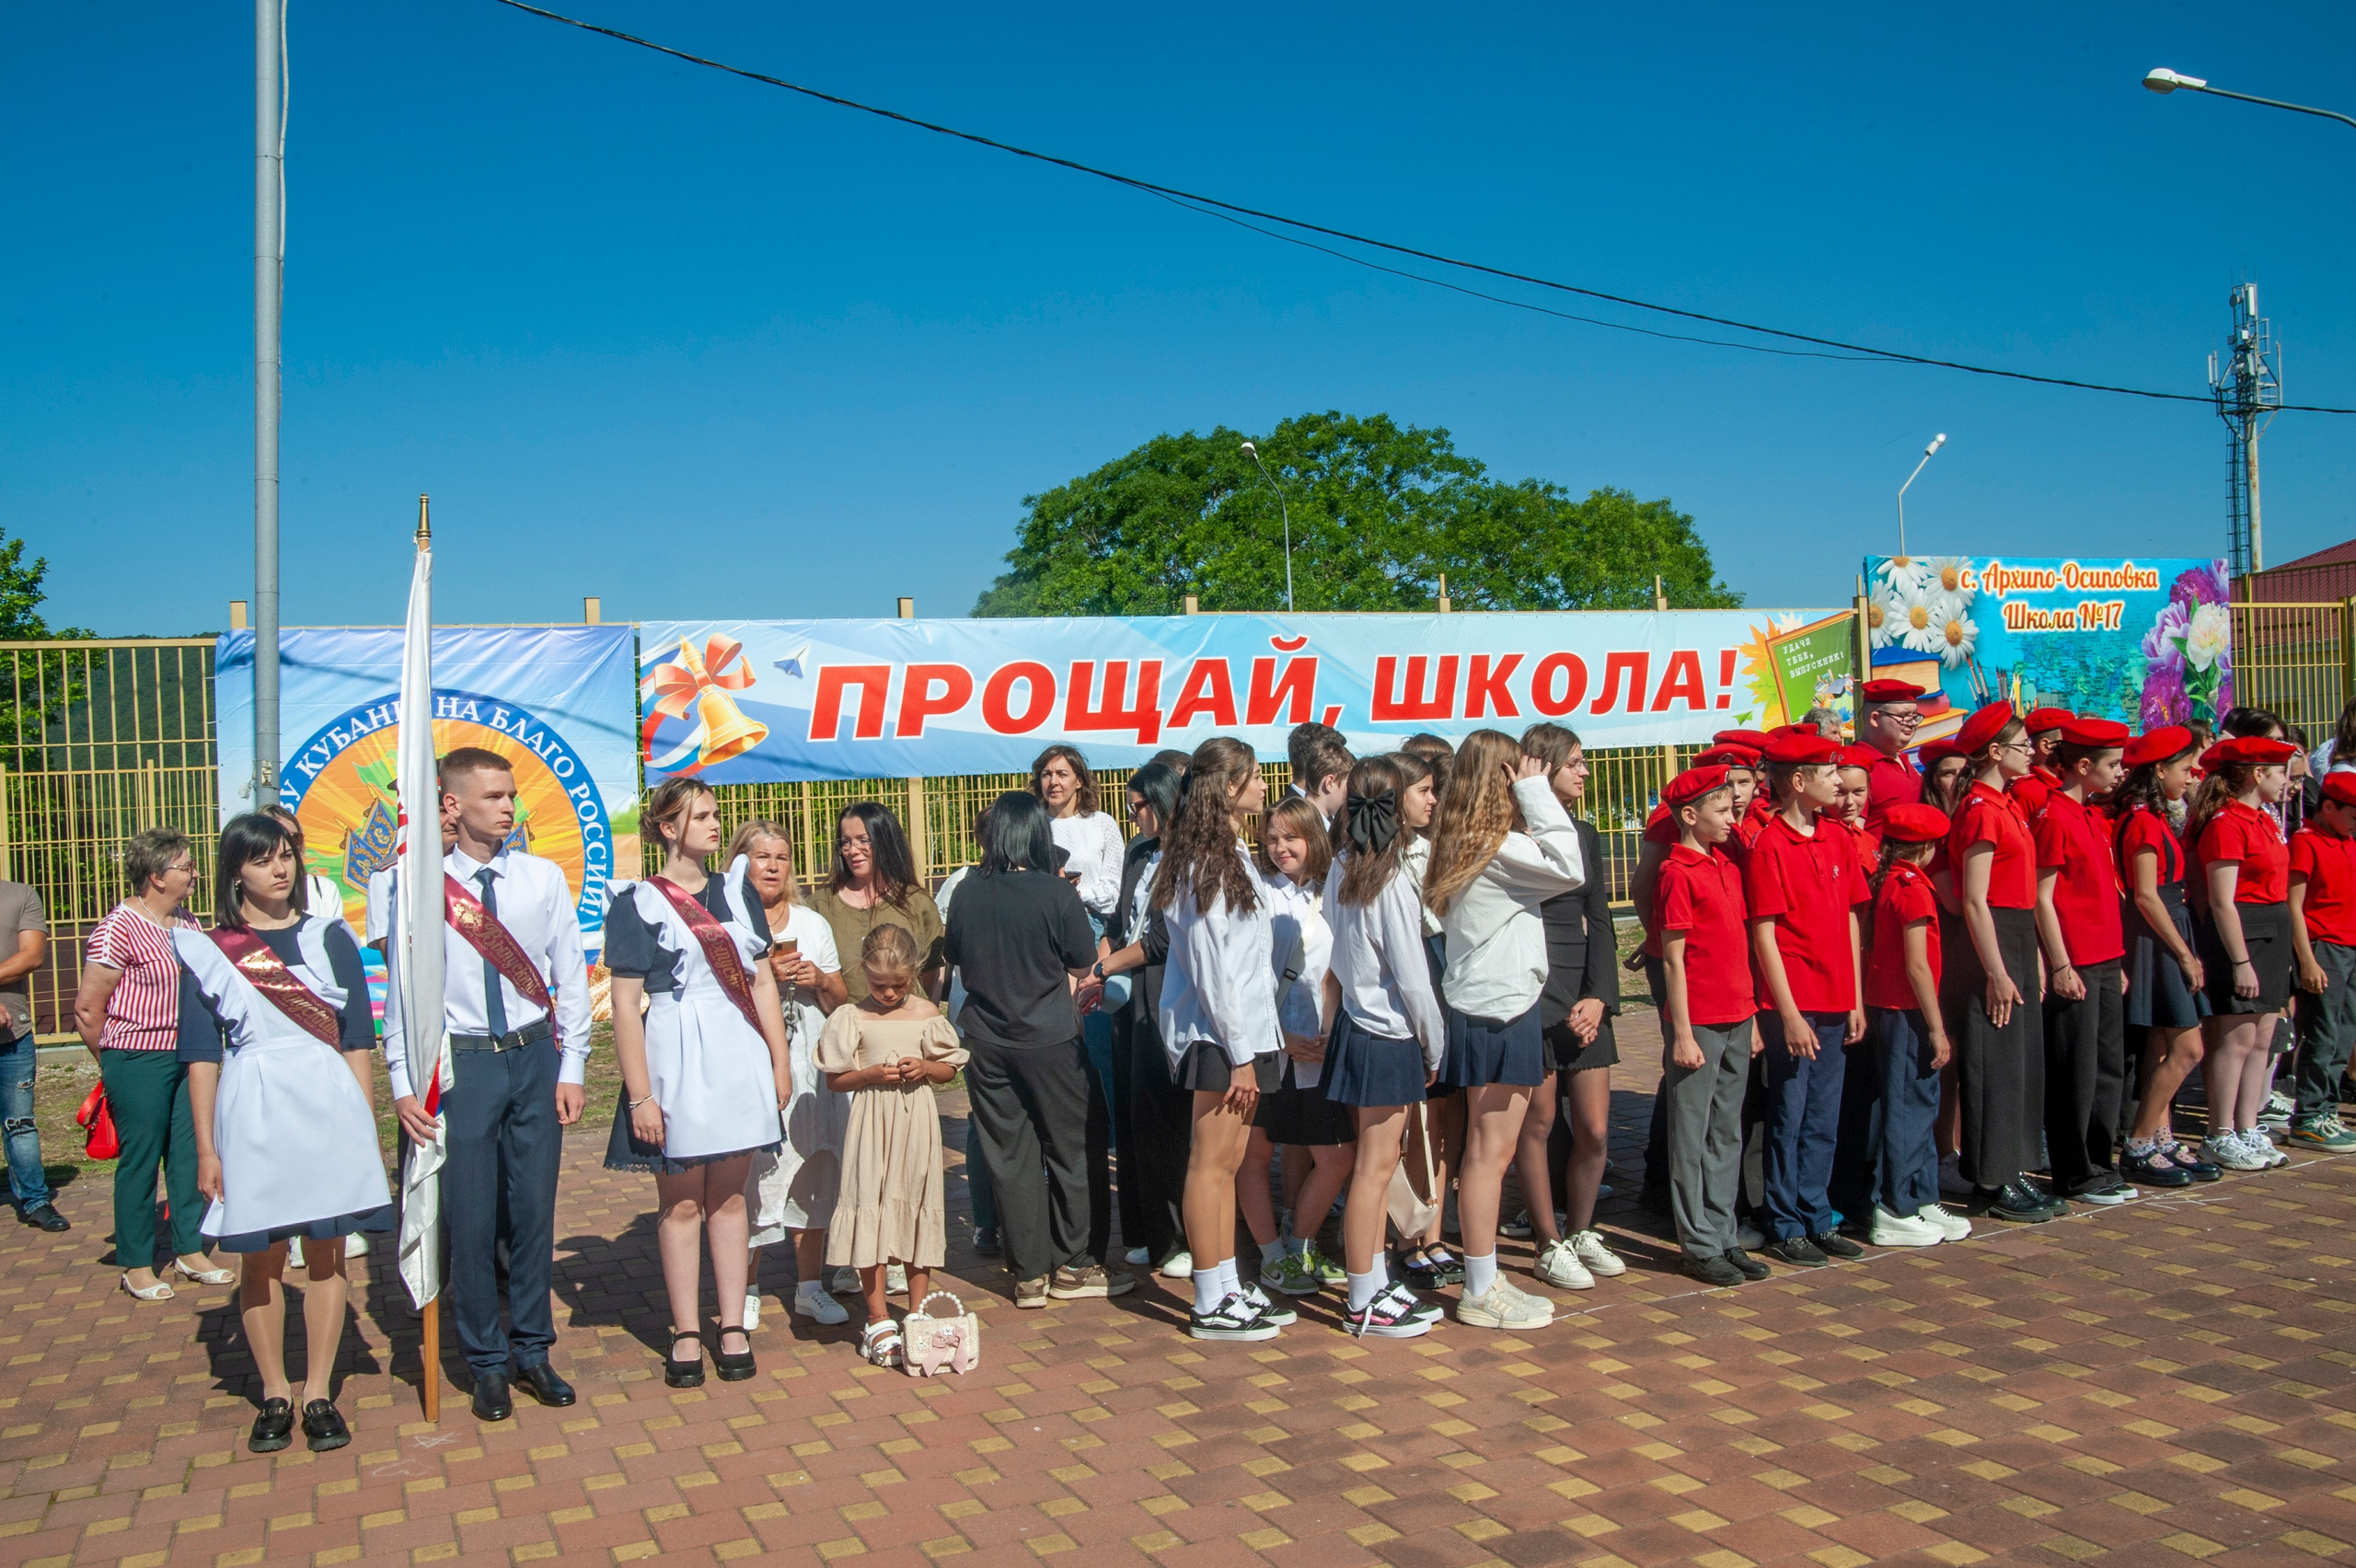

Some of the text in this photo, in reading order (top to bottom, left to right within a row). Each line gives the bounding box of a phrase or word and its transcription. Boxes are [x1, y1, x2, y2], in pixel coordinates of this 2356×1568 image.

[1960, 562, 2158, 596] с. Архипо-Осиповка
[2003, 602, 2123, 630] Школа №17
[1782, 637, 1811, 654] УДАЧИ
[1785, 651, 1814, 666] ТЕБЕ,
[1789, 651, 1844, 678] ВЫПУСКНИК!
[807, 634, 1739, 746] ПРОЩАЙ, ШКОЛА!
[435, 697, 481, 721] НА
[489, 707, 575, 778] БЛАГО
[569, 781, 607, 917] РОССИИ!
